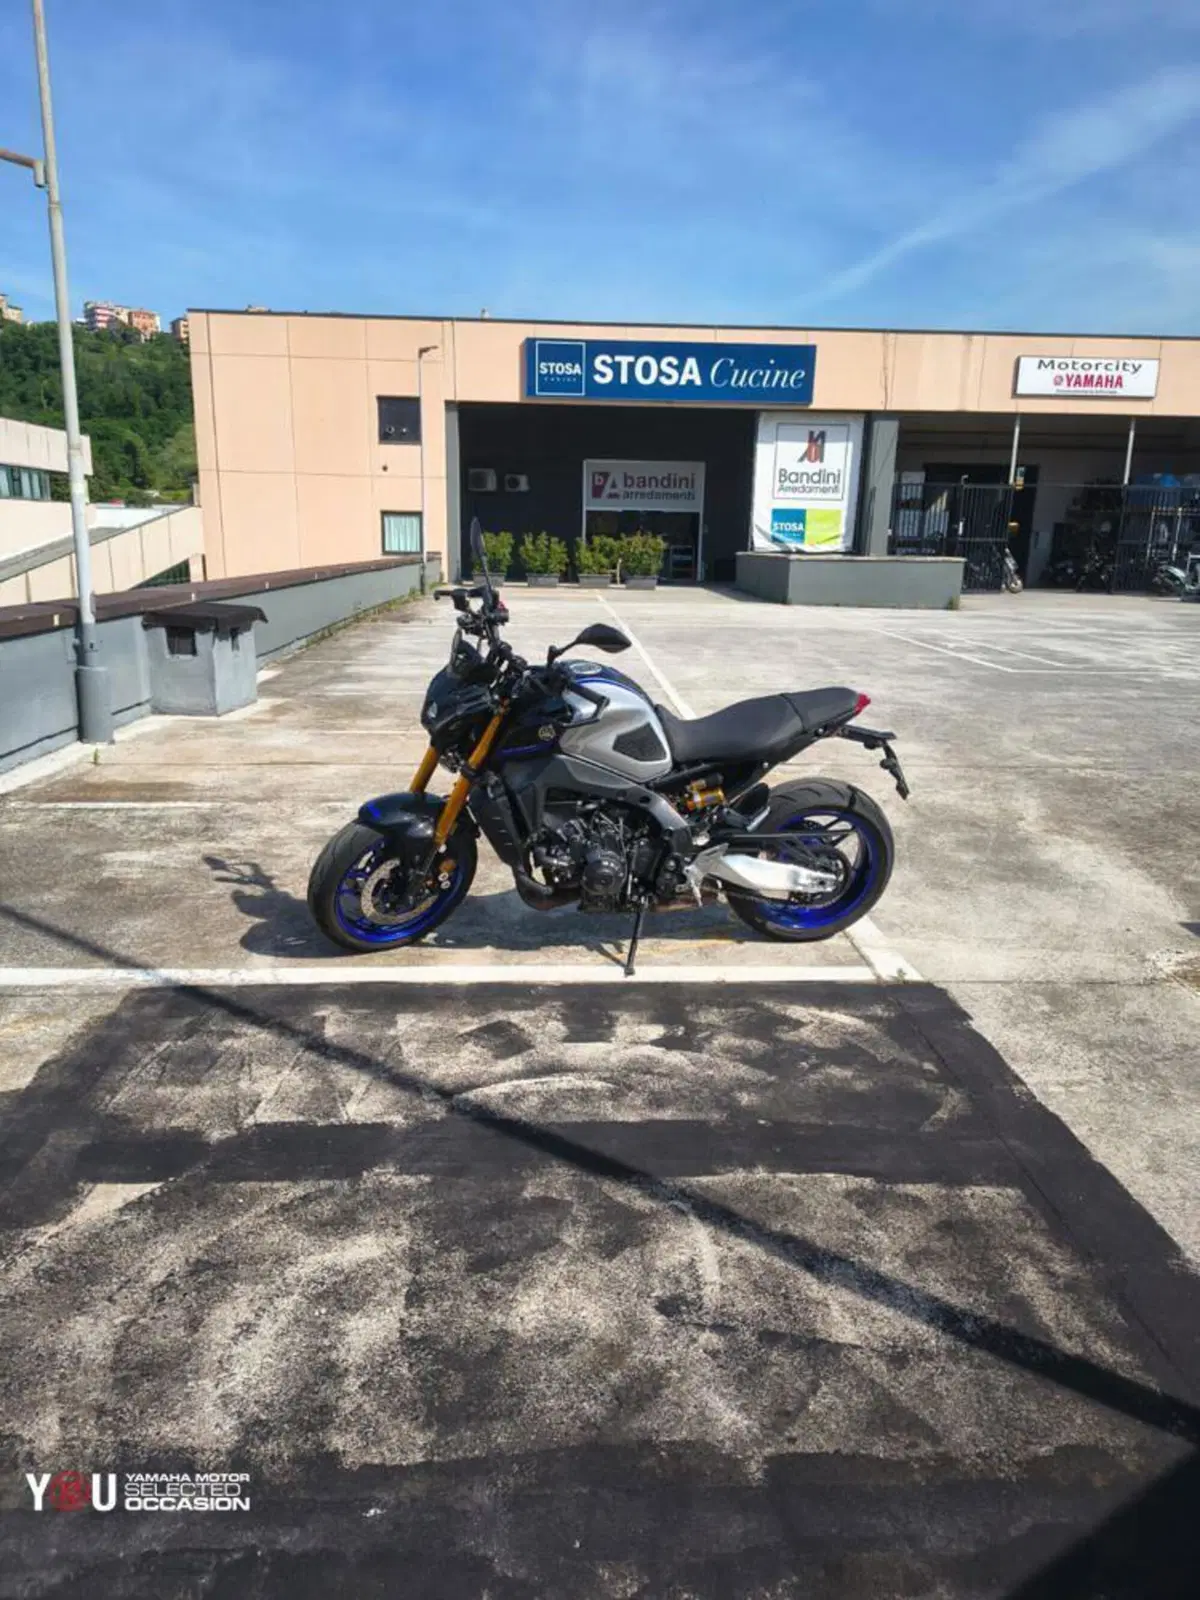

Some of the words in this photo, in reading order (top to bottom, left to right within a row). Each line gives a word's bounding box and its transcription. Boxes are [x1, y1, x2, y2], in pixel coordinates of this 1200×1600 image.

[539, 361, 582, 375] STOSA
[593, 354, 702, 386] STOSA
[710, 357, 806, 389] Cucine
[1037, 358, 1142, 374] Motorcity
[1066, 374, 1123, 388] YAMAHA
[623, 471, 696, 489] bandini
[778, 468, 841, 484] Bandini
[772, 521, 804, 533] STOSA
